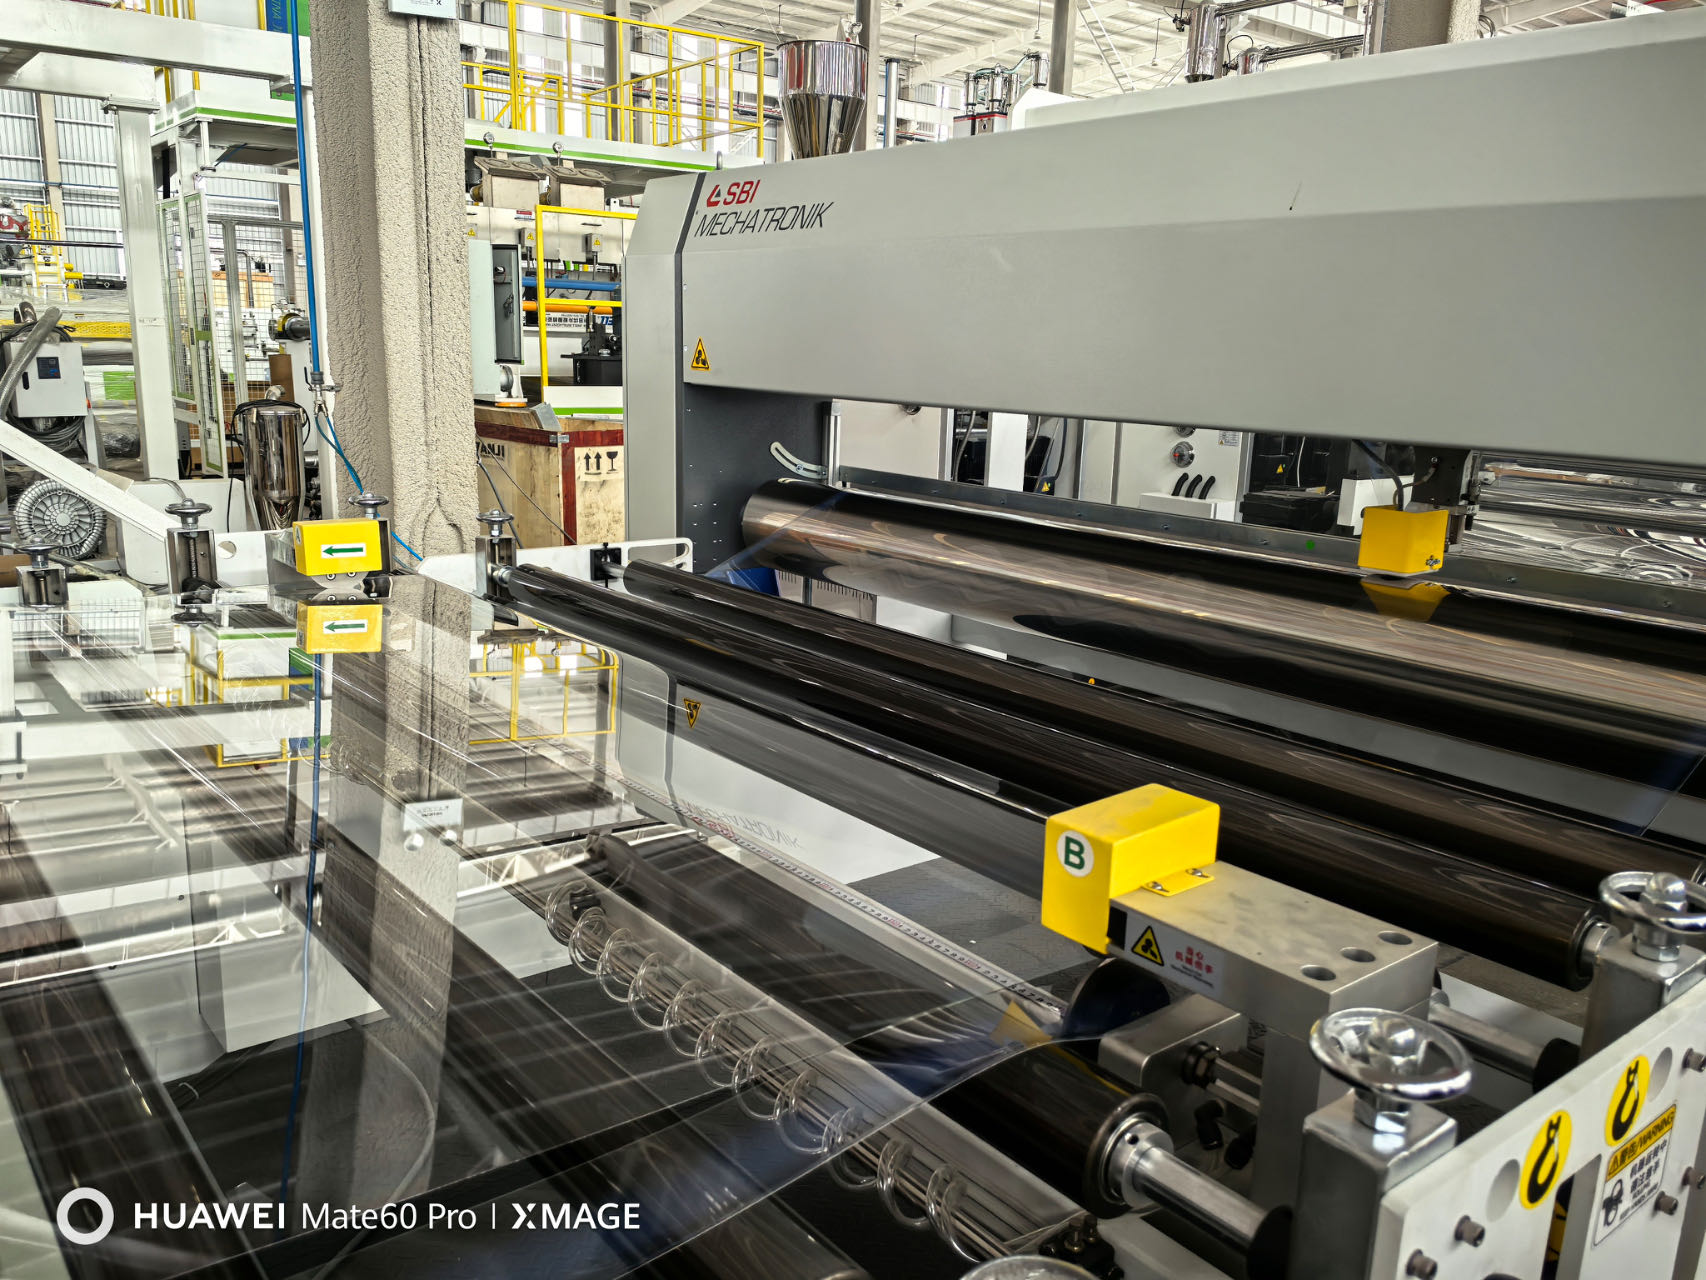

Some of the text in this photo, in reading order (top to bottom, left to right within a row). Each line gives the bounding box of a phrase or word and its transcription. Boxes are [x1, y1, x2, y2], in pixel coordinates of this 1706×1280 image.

[723, 179, 761, 205] SBI
[694, 201, 834, 237] MECHATRONIK
[1064, 835, 1085, 870] B
